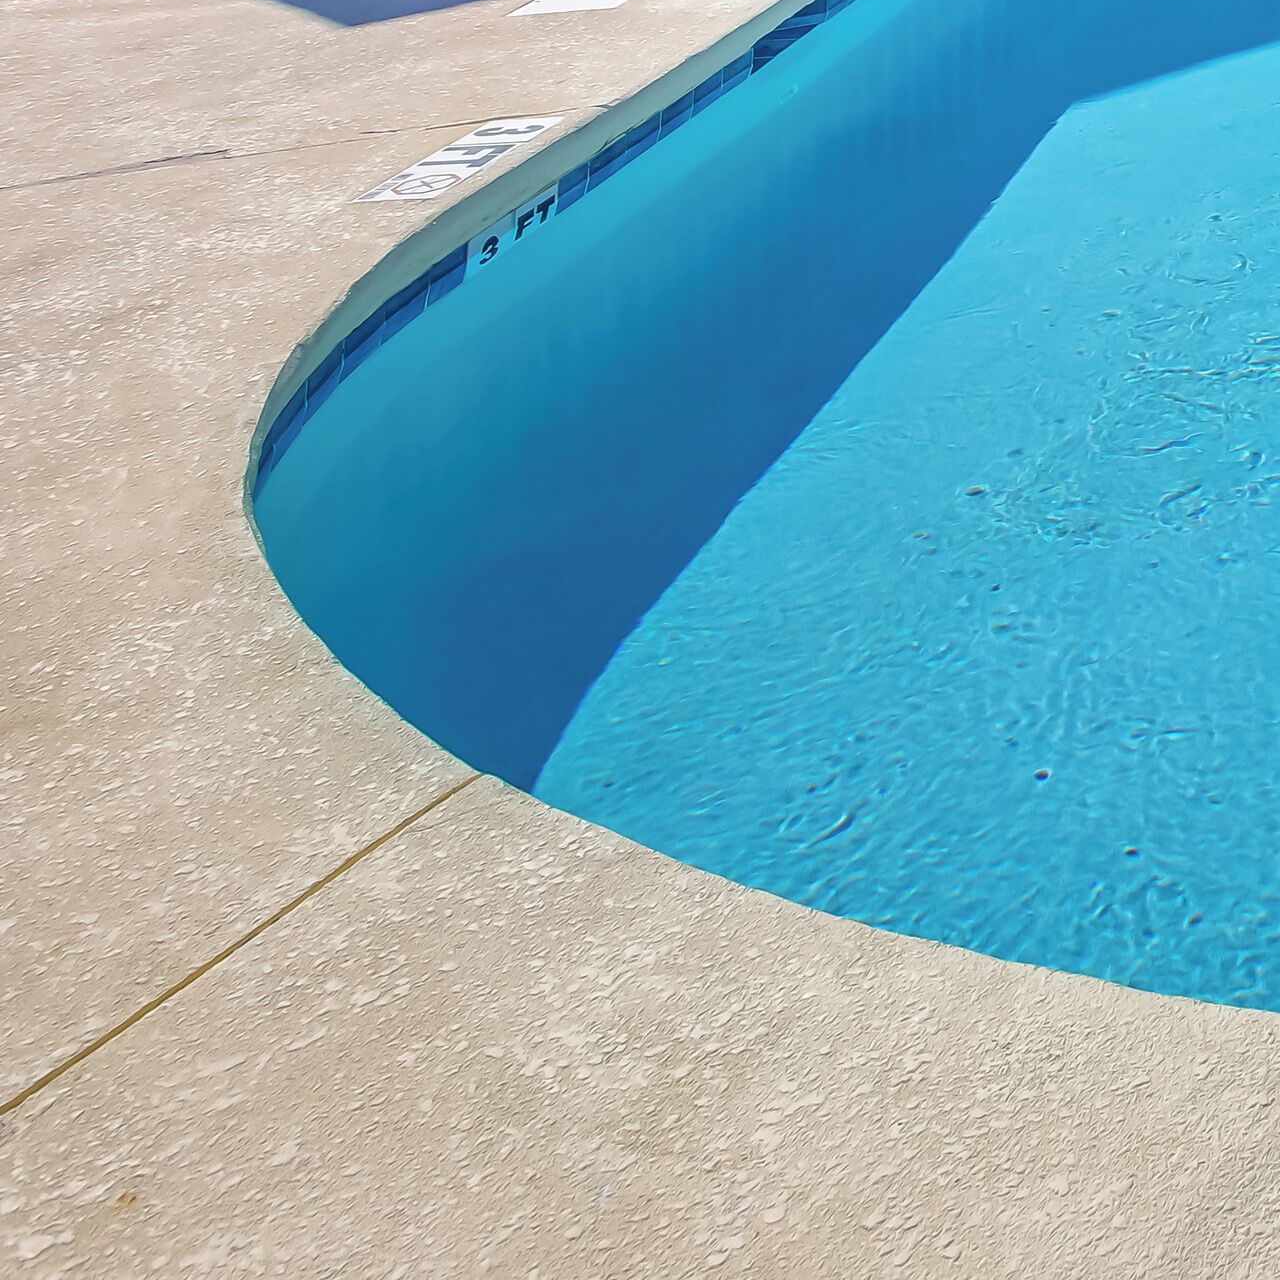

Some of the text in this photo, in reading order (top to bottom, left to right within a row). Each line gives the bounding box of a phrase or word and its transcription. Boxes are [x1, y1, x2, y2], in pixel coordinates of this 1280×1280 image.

[416, 124, 545, 169] 3 FT
[479, 195, 556, 265] 3 FT
